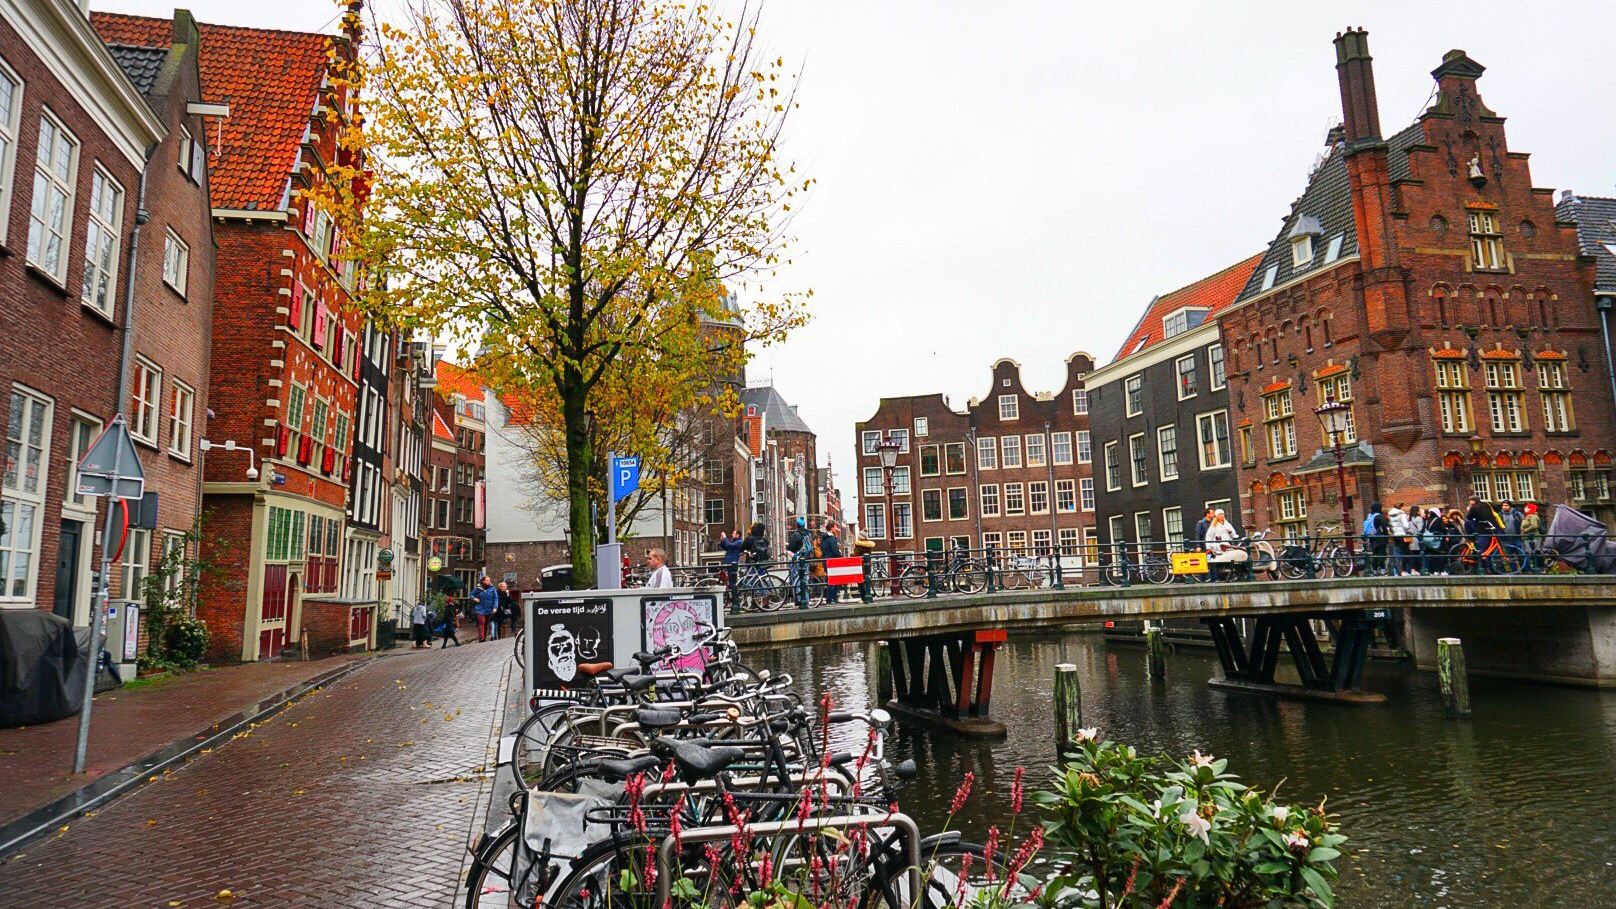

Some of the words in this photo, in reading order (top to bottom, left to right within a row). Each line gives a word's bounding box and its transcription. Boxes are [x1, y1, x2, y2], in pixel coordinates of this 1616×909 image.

[621, 470, 631, 487] P
[537, 607, 549, 615] De
[572, 606, 585, 615] tijd
